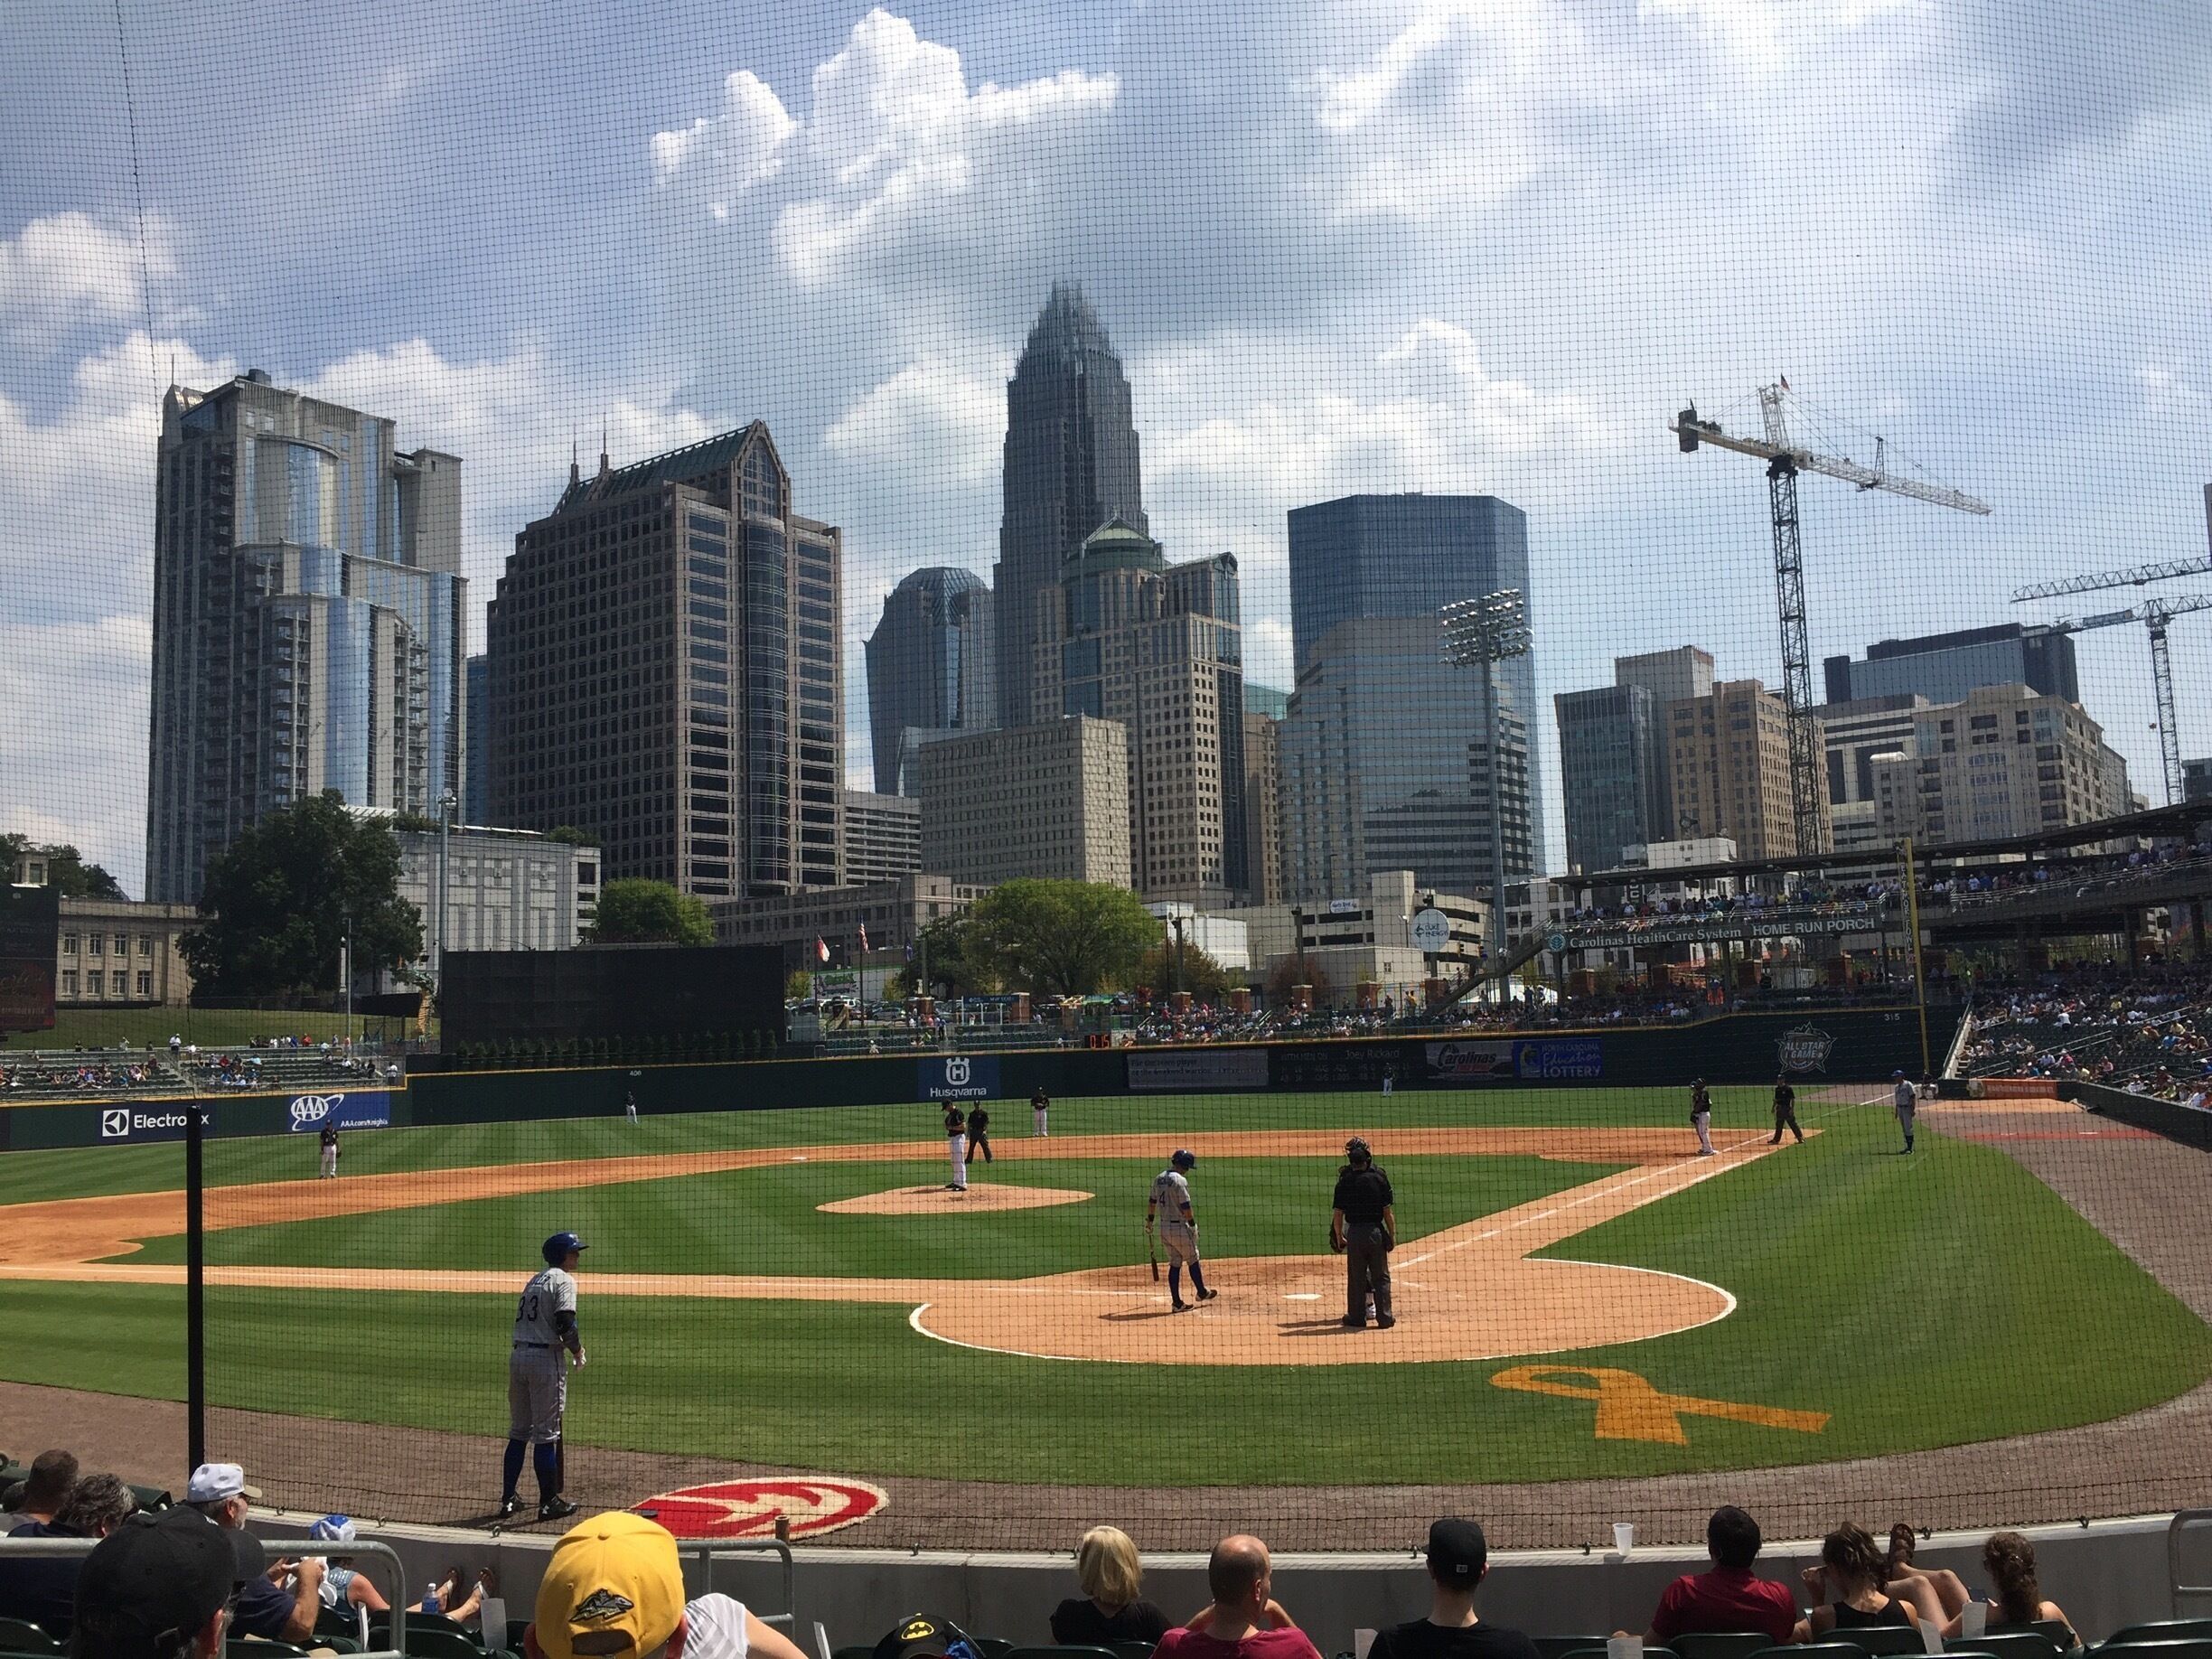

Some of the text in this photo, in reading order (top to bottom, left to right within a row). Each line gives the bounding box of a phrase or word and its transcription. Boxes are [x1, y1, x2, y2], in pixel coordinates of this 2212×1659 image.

[1570, 917, 1875, 948] Carolinas HealthCare System HOME RUN PORCH
[1884, 1013, 1901, 1021] 315
[1438, 1044, 1497, 1067] Carolinas
[1542, 1051, 1601, 1066] Education
[1791, 1050, 1817, 1059] GAME
[1542, 1065, 1601, 1078] LOTTERY
[930, 1086, 988, 1099] Husqvarna
[295, 1096, 324, 1120] AAA
[134, 1112, 210, 1129] Electrox
